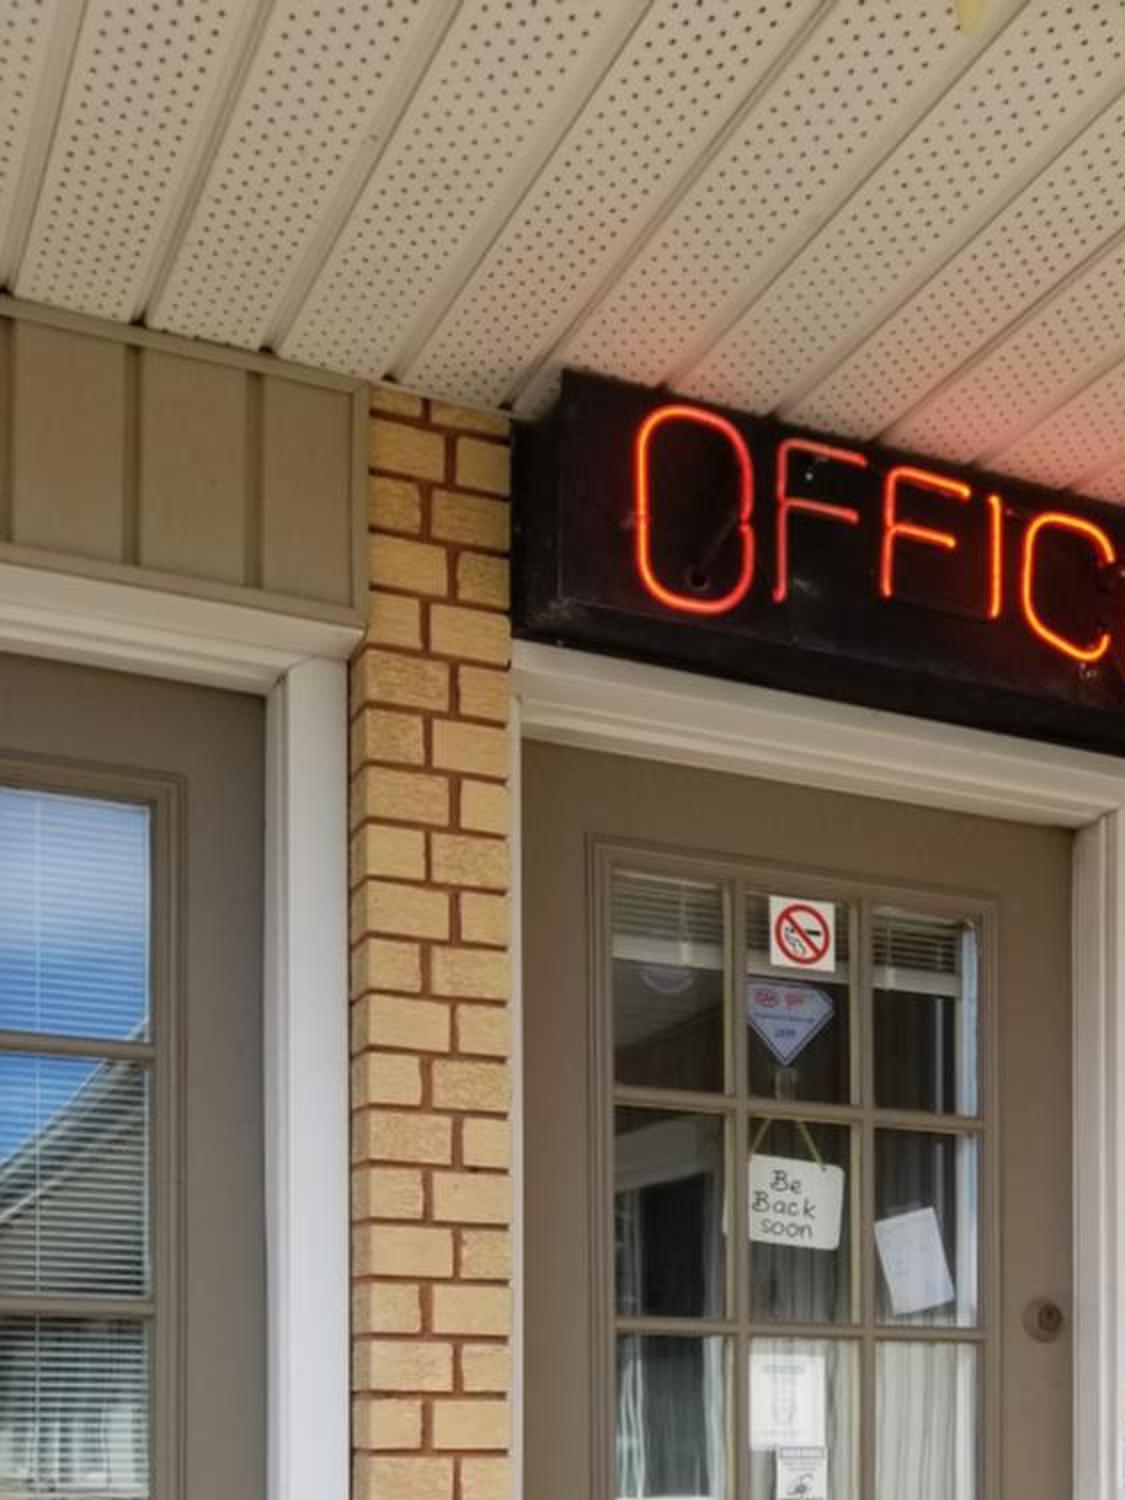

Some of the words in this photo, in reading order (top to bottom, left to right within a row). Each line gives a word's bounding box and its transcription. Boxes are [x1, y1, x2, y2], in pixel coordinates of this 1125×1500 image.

[770, 1169, 801, 1194] Be
[751, 1190, 817, 1221] Back
[760, 1216, 813, 1239] soon
